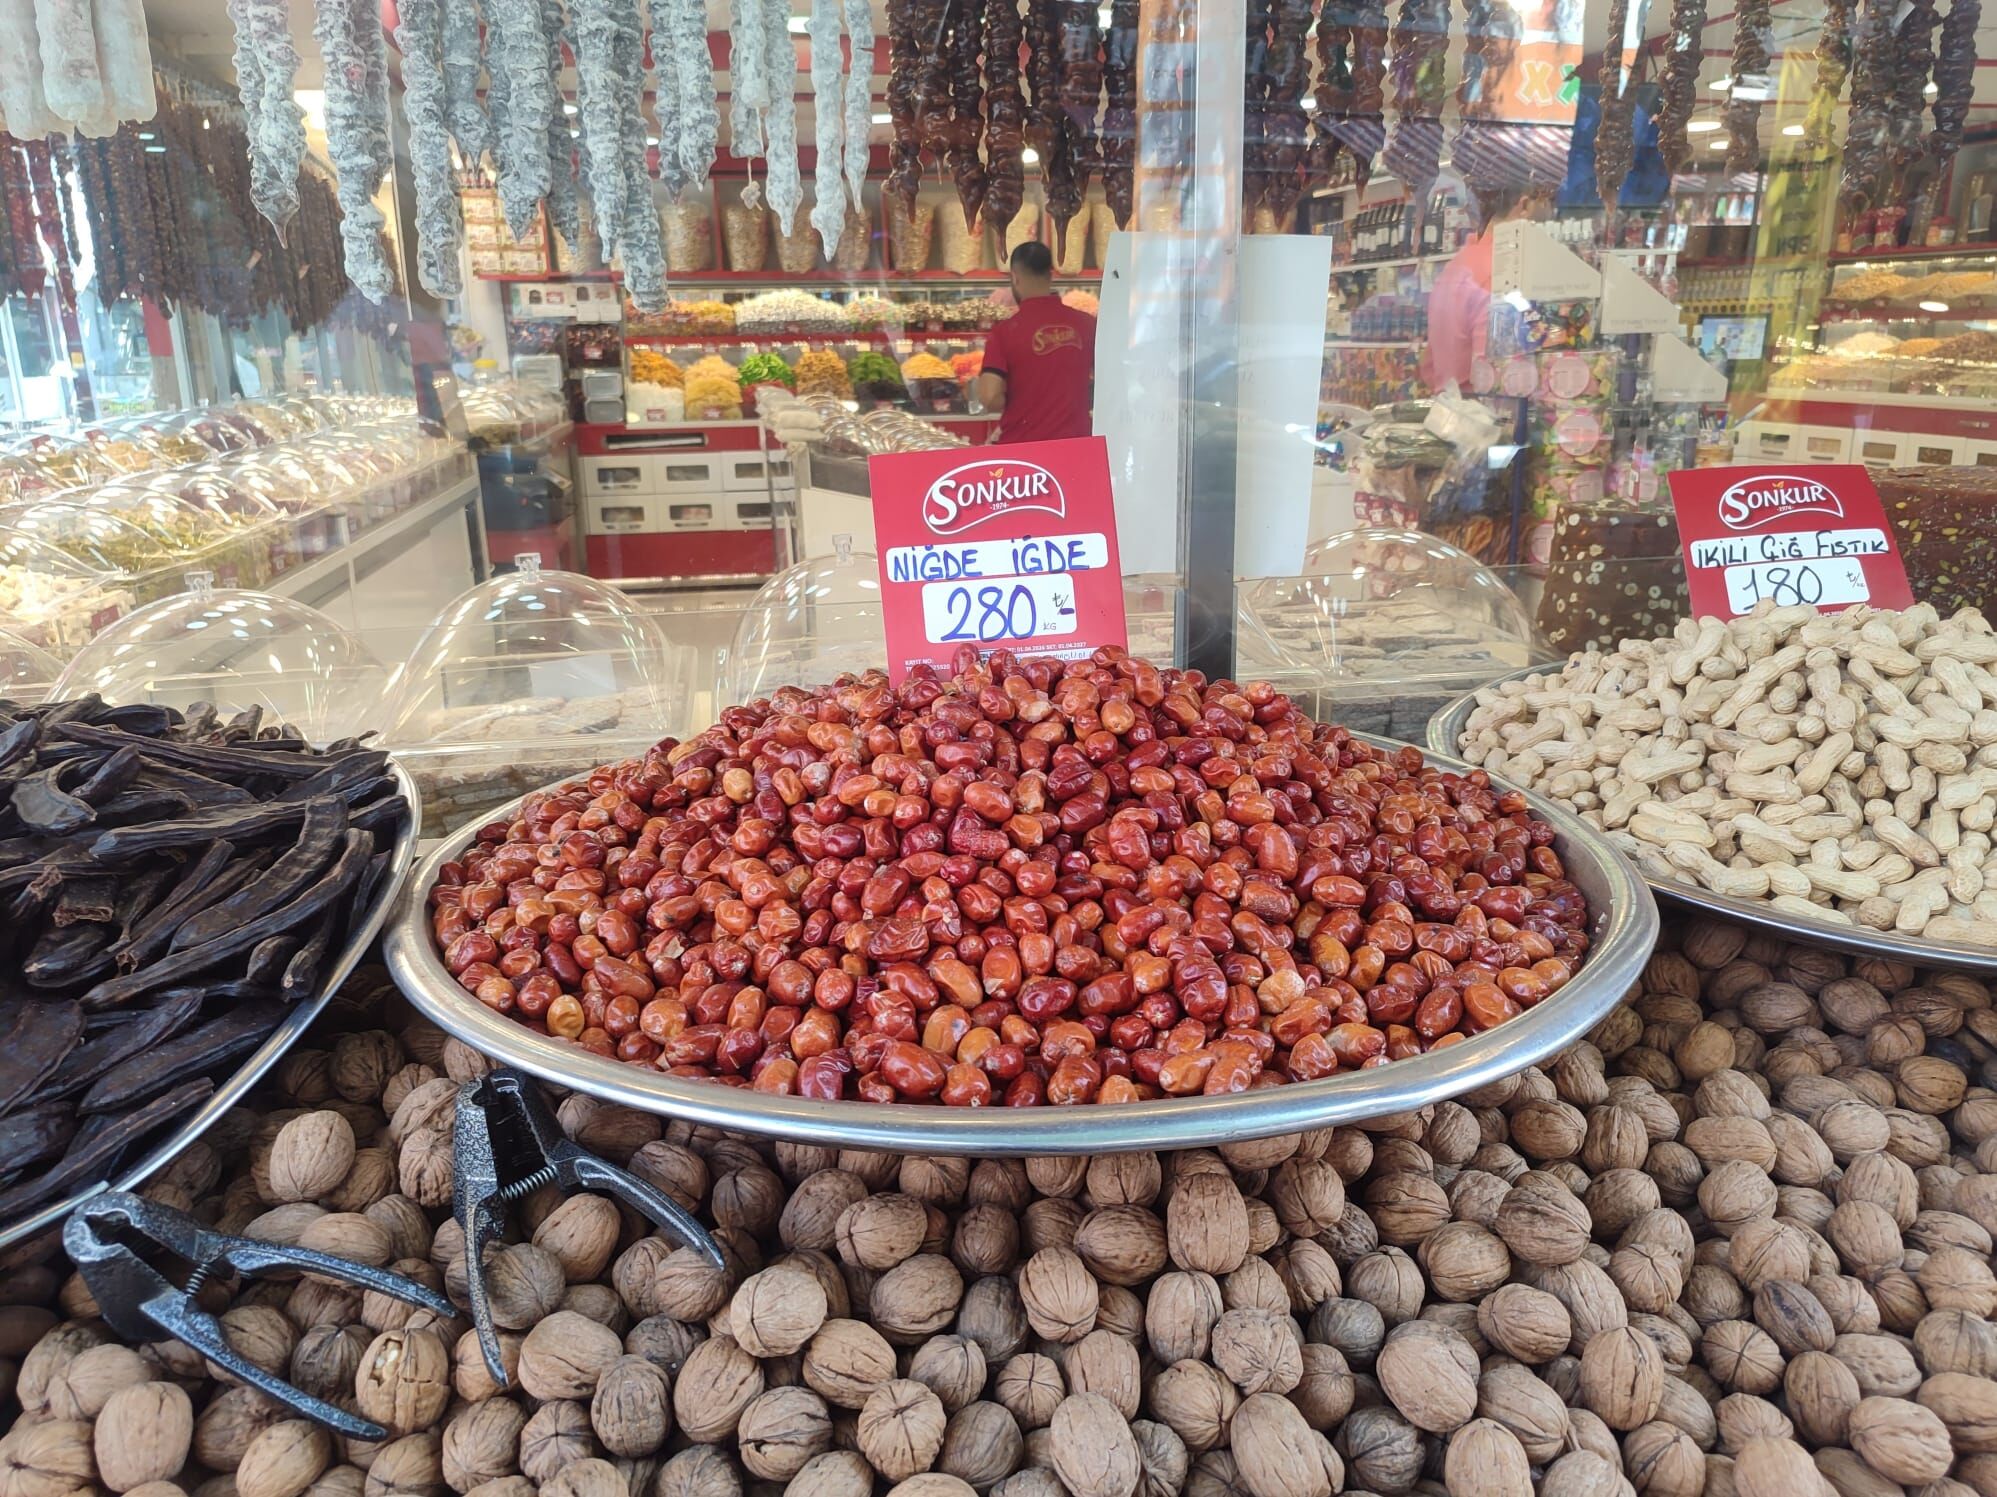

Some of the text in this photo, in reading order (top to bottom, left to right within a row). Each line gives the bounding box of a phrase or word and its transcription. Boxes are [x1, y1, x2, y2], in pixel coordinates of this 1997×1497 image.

[928, 472, 1049, 525] SONKUR
[1725, 485, 1826, 523] SONKUR
[1743, 566, 1822, 610] 180
[940, 585, 1036, 641] 280
